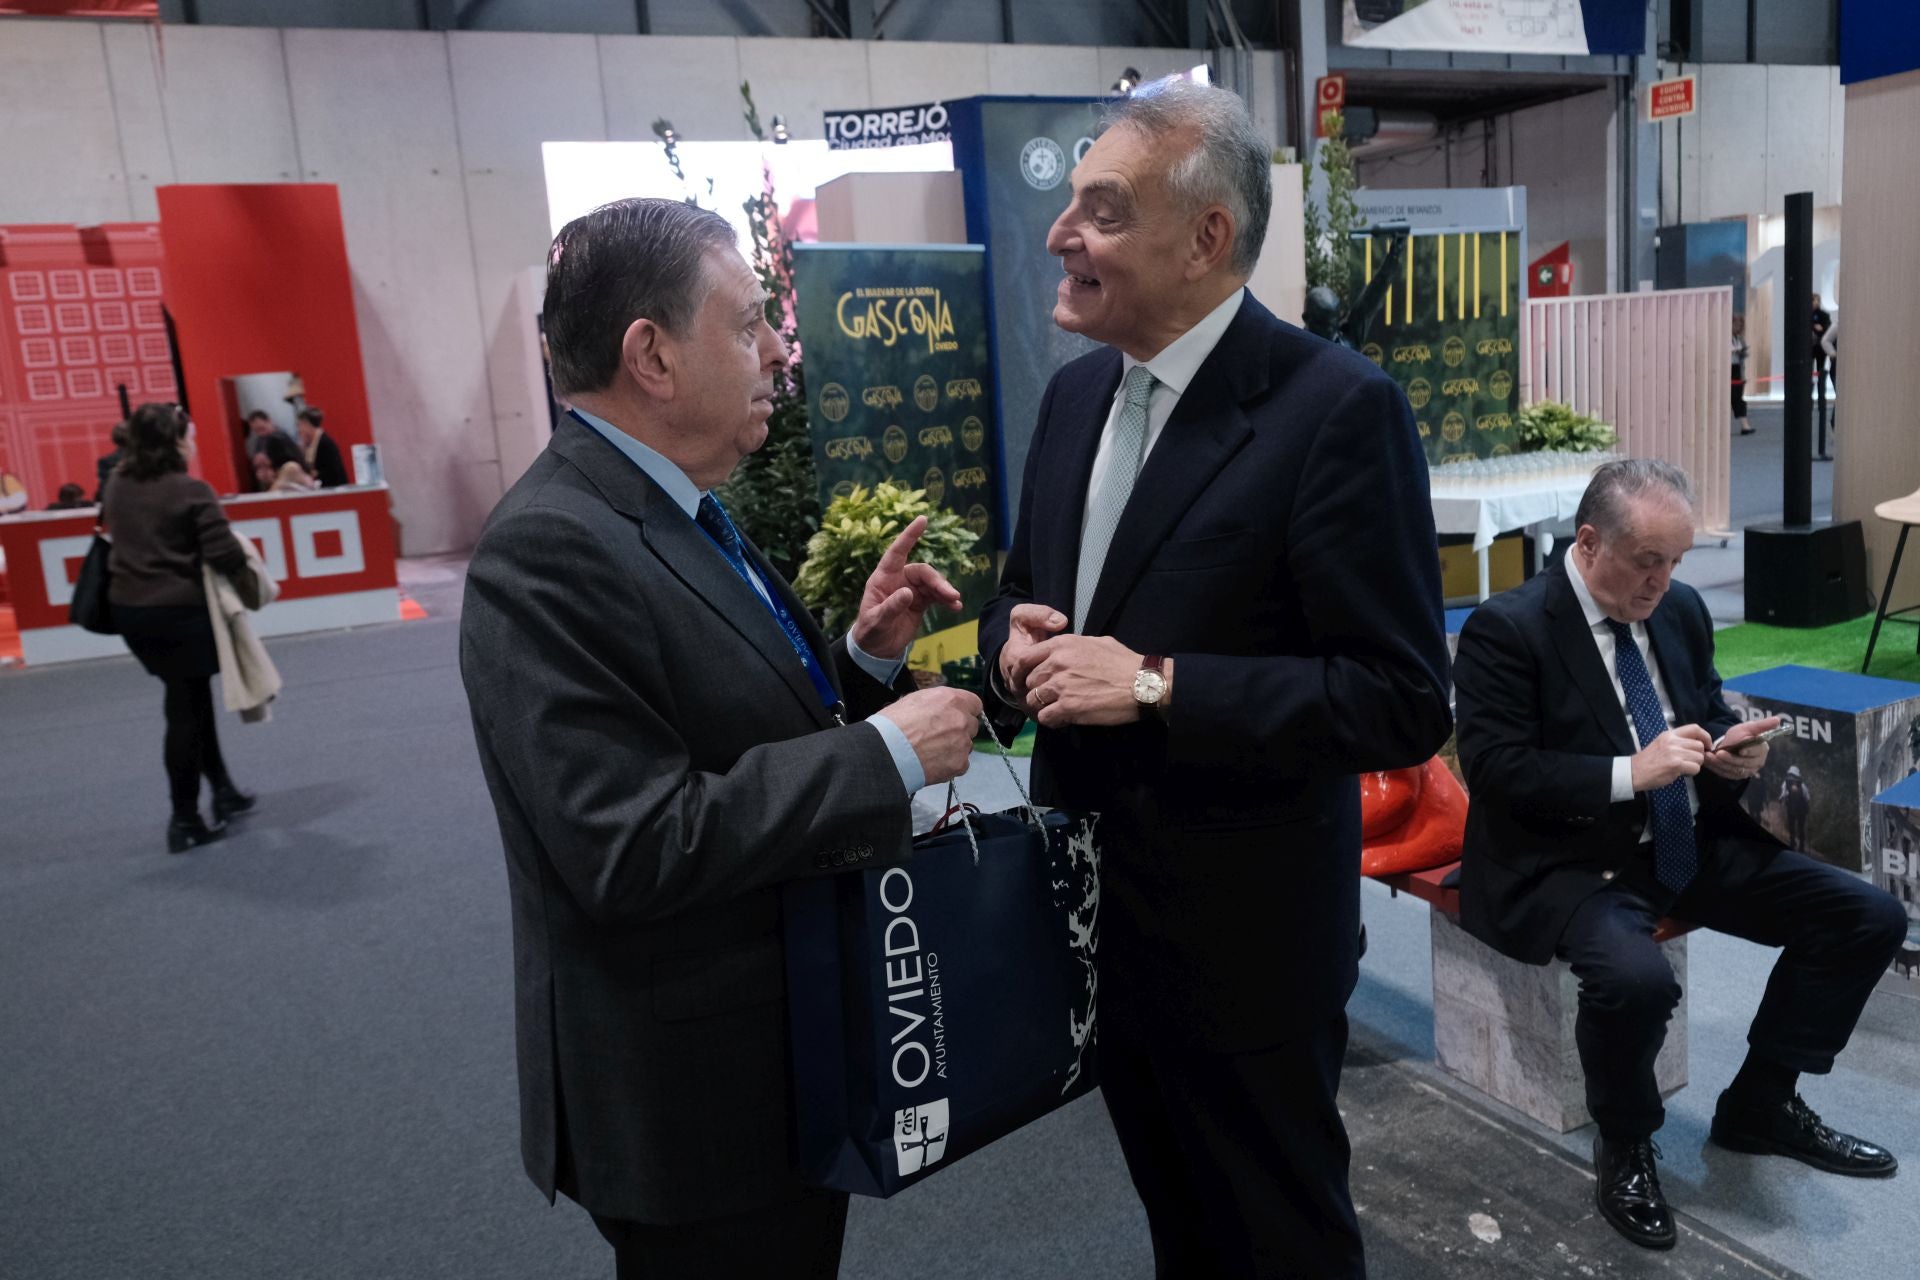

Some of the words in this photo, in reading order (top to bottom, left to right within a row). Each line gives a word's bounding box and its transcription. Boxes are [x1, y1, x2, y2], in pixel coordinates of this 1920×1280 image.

[1659, 93, 1686, 105] CONTRA
[1660, 83, 1685, 95] EQUIPO
[825, 100, 951, 138] TORREJÓ
[837, 288, 955, 354] GASCONA
[879, 867, 930, 1088] OVIEDO
[926, 952, 948, 1079] AYUNTAMIENTO
